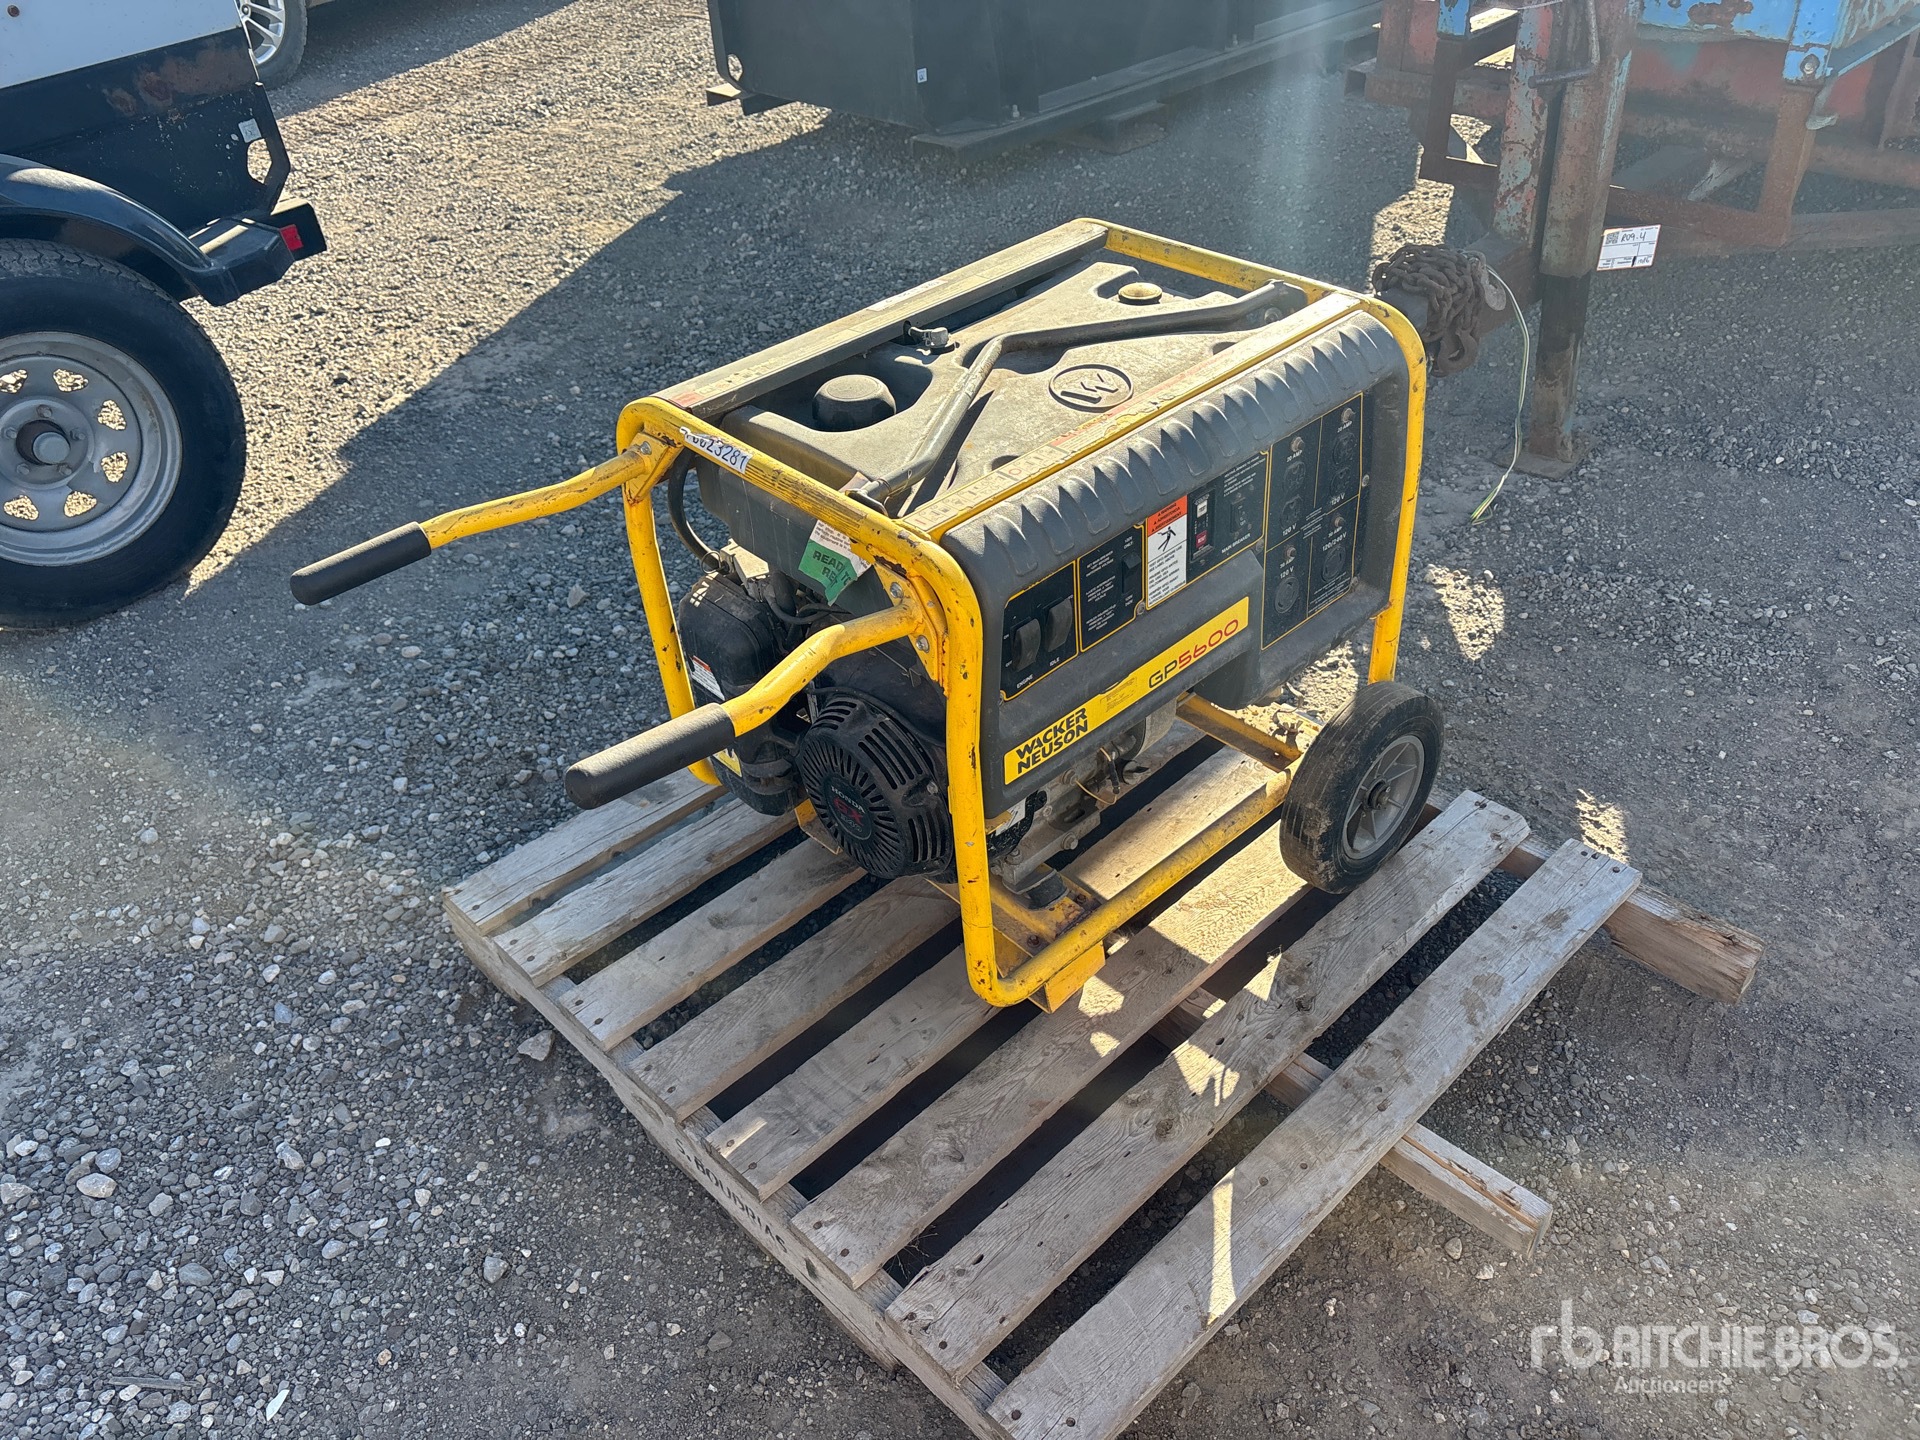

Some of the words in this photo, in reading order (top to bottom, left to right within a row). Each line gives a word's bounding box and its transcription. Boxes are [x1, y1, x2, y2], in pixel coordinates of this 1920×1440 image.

[1148, 619, 1239, 689] GP5600
[1016, 674, 1034, 688] ENGINE
[1016, 708, 1088, 760] WACKER
[1017, 720, 1089, 774] NEUSON
